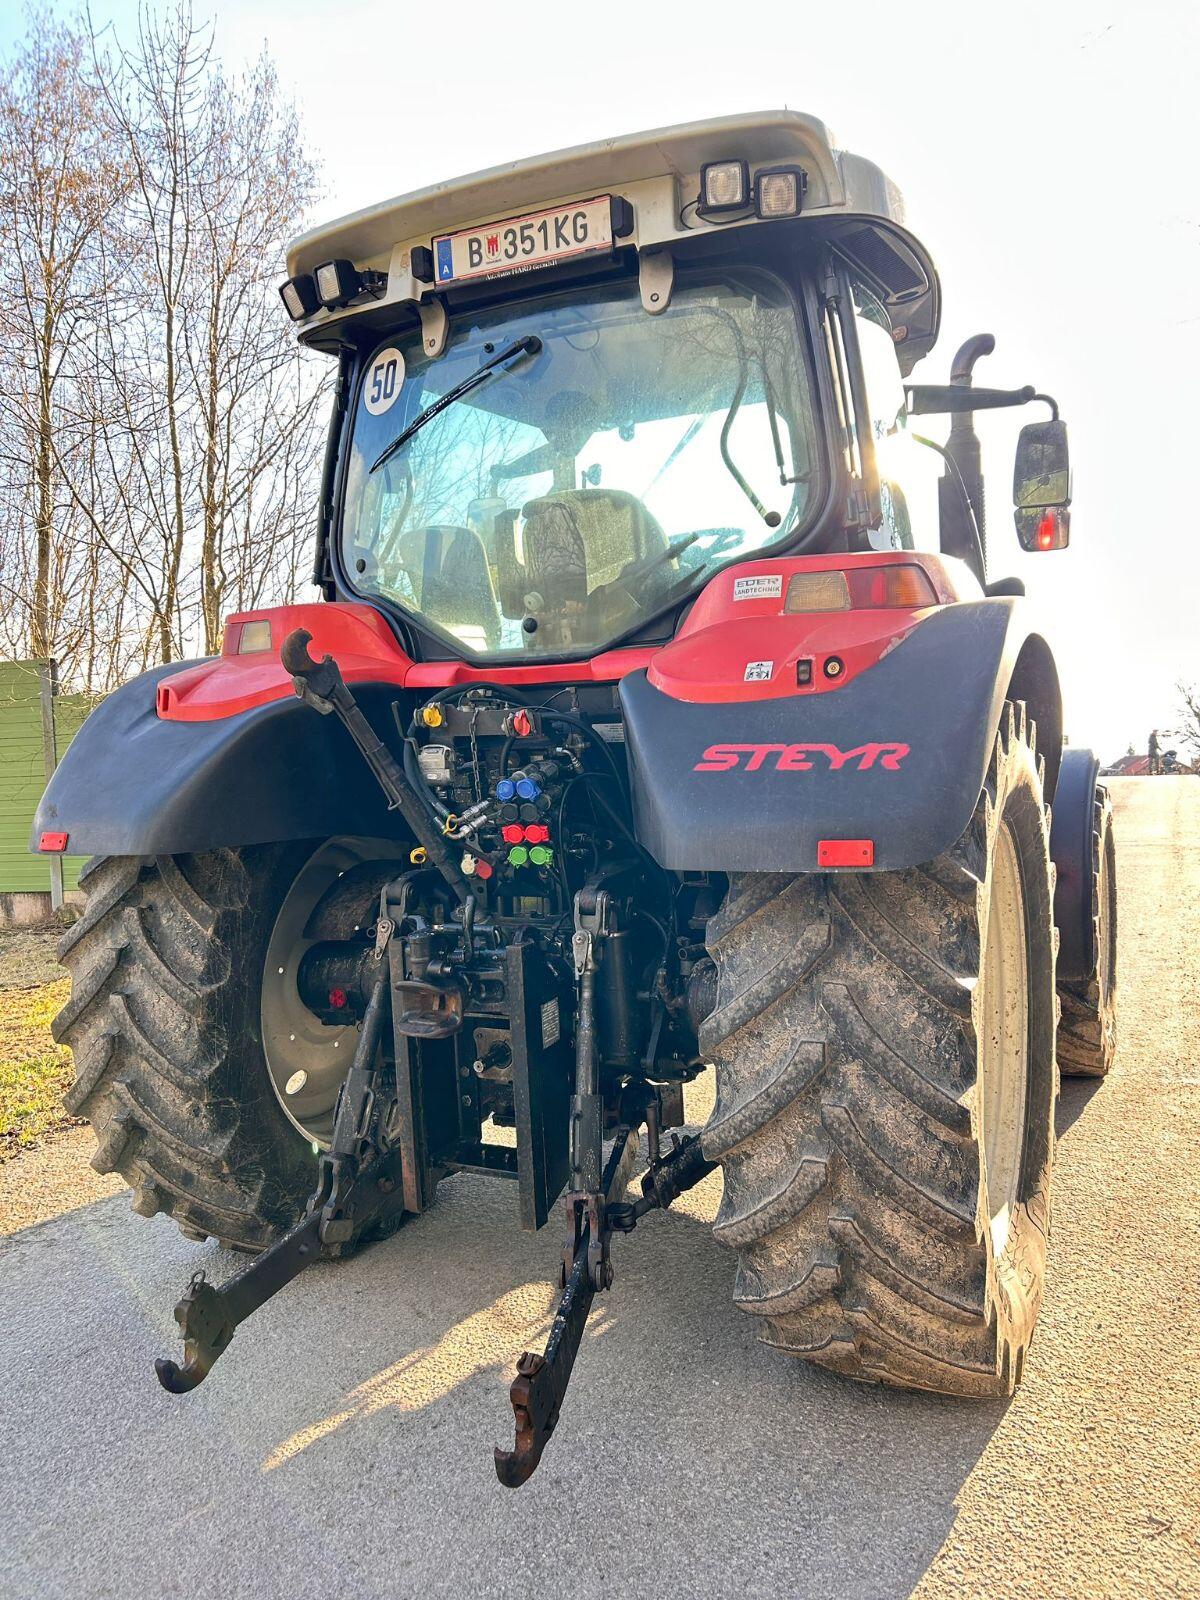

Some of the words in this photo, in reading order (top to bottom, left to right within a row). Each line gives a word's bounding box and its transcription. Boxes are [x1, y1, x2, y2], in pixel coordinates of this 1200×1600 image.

[468, 236, 483, 268] B
[503, 211, 588, 259] 351KG
[442, 264, 450, 275] A
[370, 358, 398, 404] 50
[735, 586, 780, 596] LANDTECHNIK
[737, 577, 779, 588] EDER
[693, 742, 911, 772] STEYR
